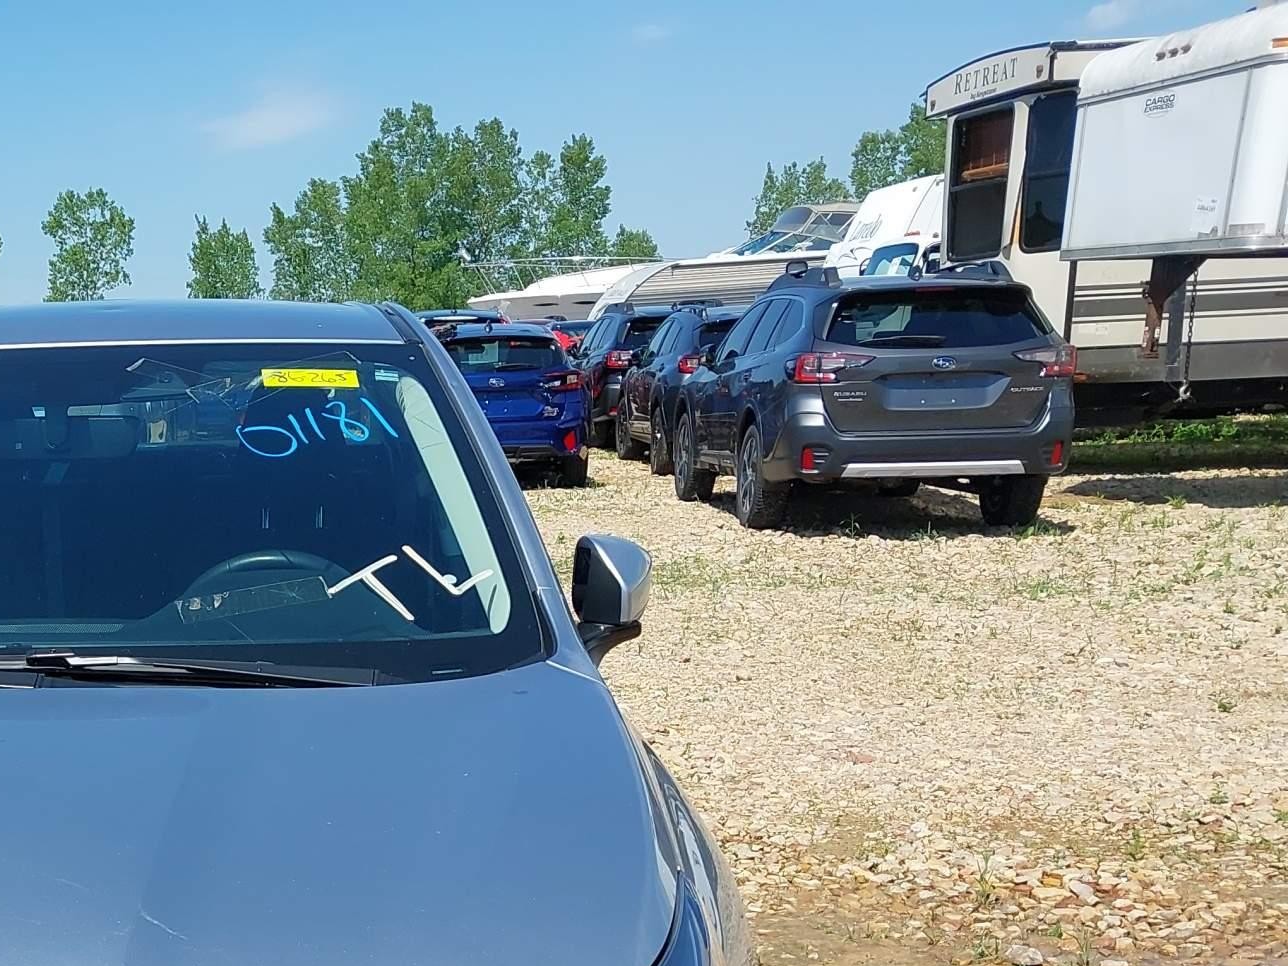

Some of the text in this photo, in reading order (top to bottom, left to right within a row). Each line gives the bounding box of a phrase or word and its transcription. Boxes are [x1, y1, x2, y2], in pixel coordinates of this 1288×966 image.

[954, 57, 1018, 95] RETREAT
[1145, 94, 1175, 107] CARGO
[235, 397, 399, 457] 01181
